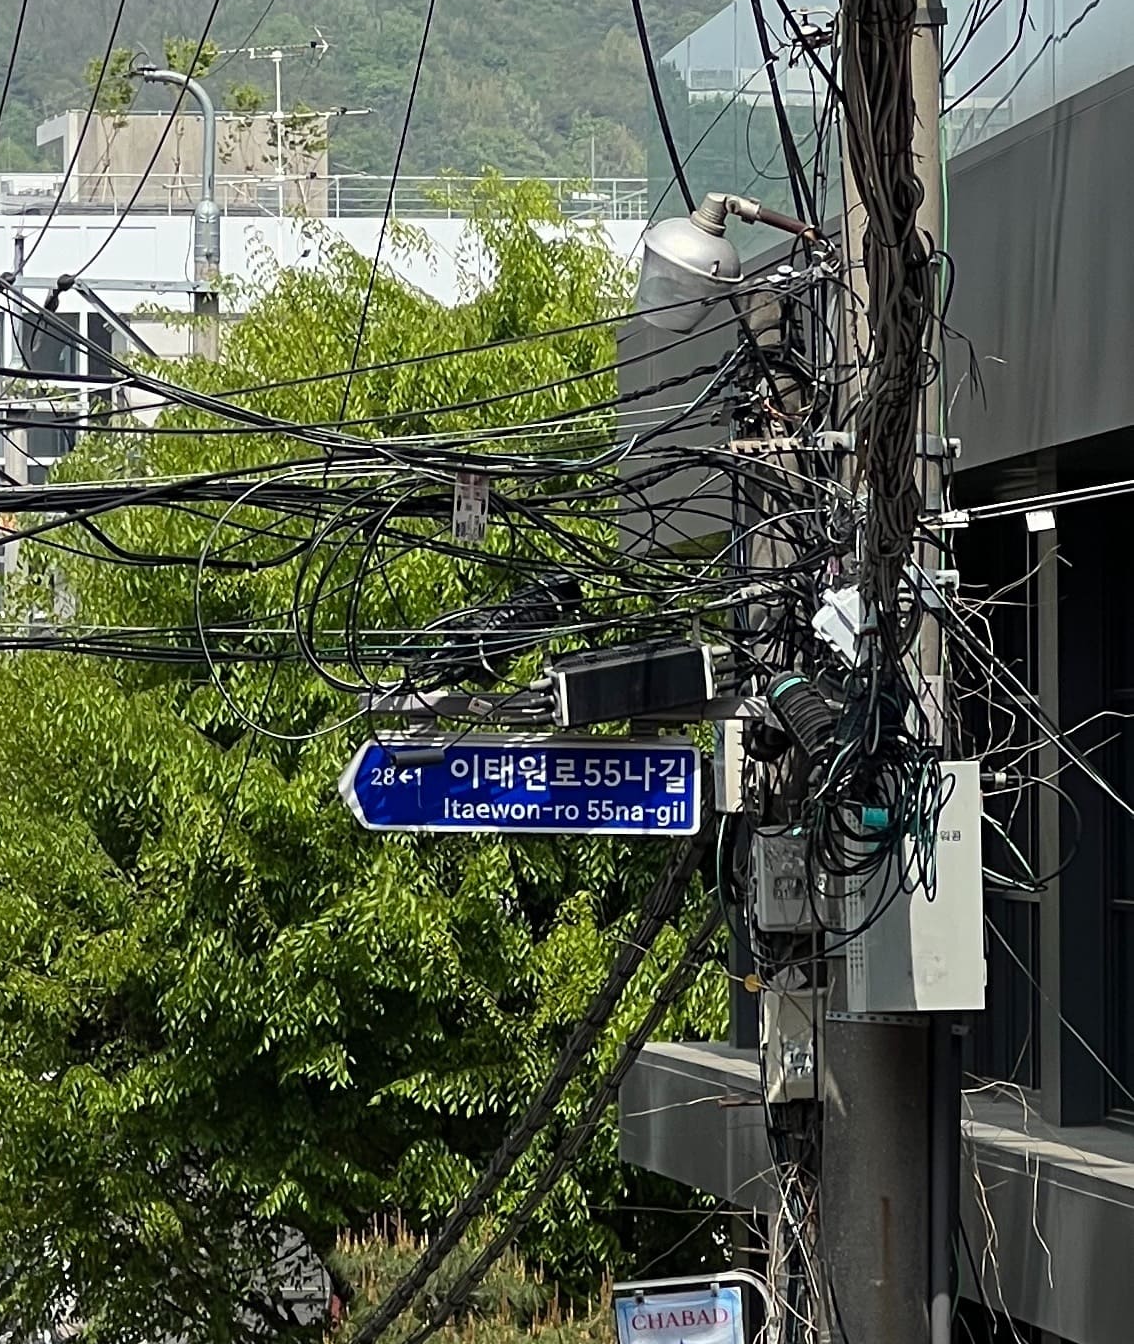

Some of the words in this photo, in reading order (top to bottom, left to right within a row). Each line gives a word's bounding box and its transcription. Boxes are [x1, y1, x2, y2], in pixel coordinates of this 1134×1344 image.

[371, 767, 396, 786] 28
[450, 754, 686, 793] 이태원로55나길
[444, 797, 579, 820] Itaewon-ro
[587, 800, 686, 826] 55na-gil
[632, 1308, 729, 1331] CHABAD
